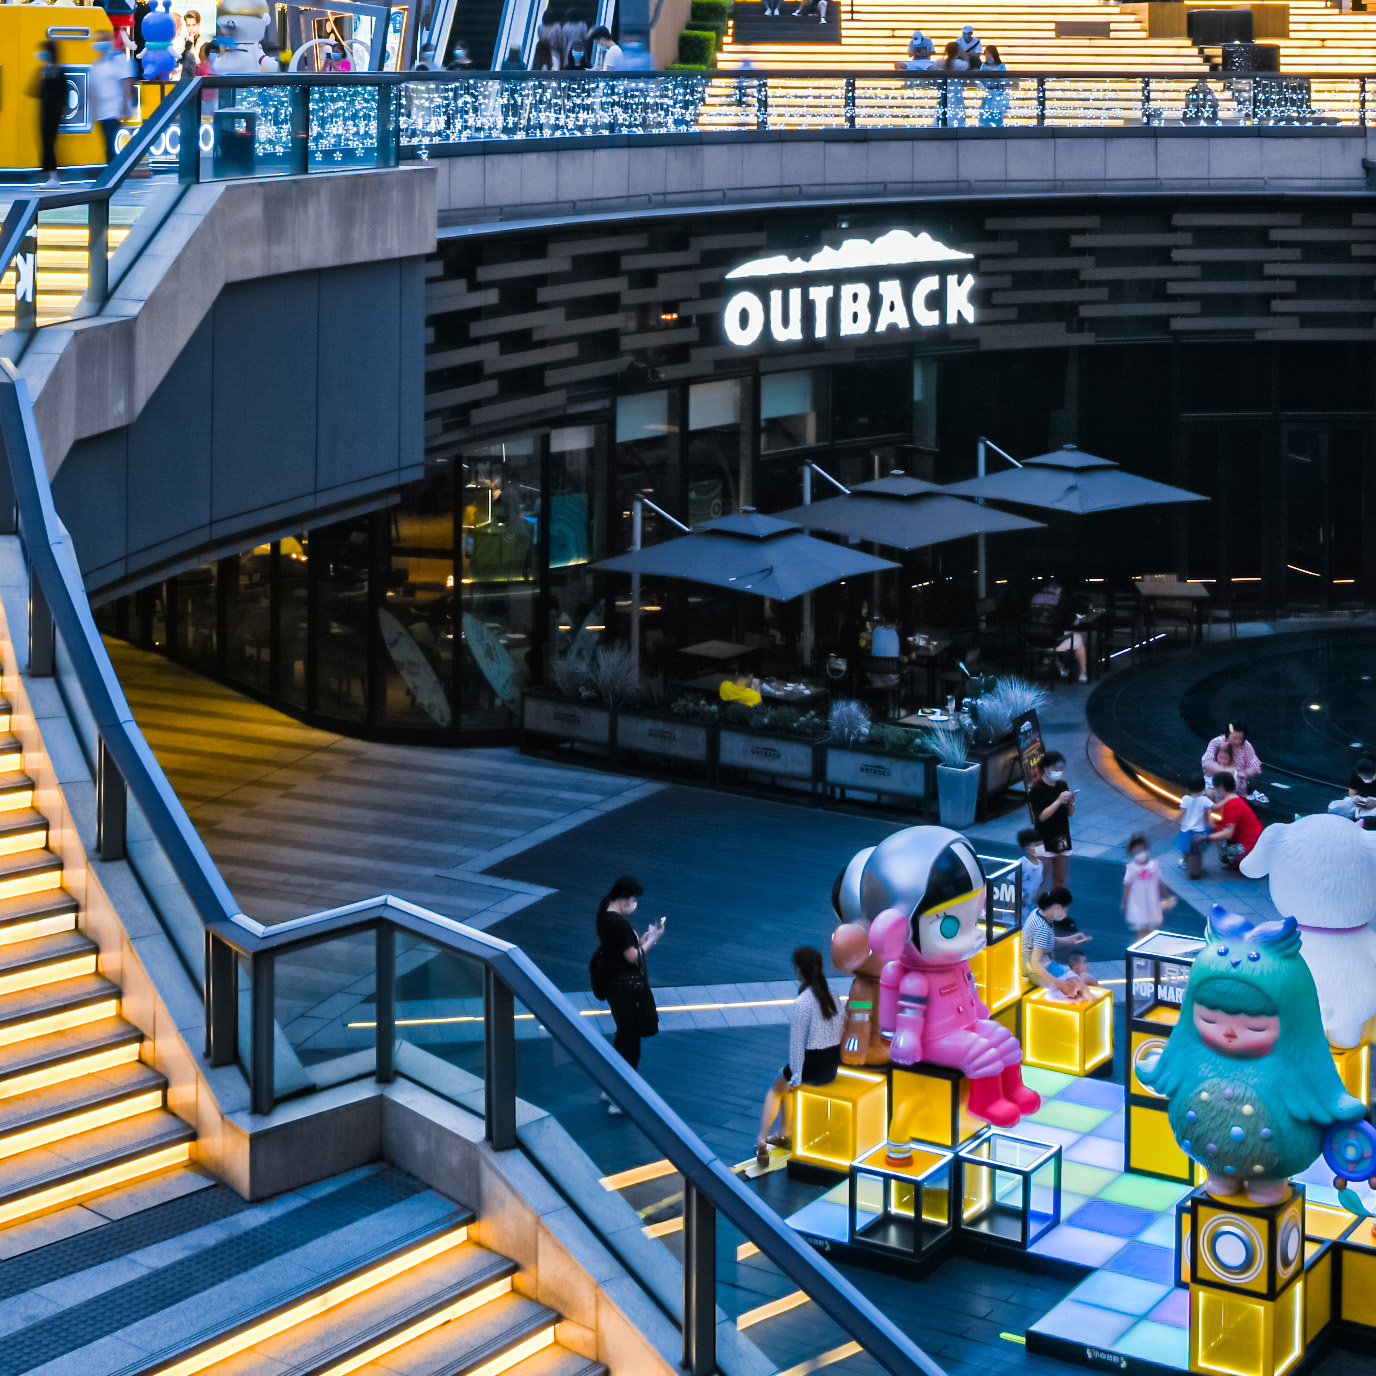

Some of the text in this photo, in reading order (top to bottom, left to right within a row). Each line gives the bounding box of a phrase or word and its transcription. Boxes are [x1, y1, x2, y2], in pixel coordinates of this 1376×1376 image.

[724, 273, 976, 346] OUTBACK
[1132, 982, 1185, 1004] POP MAR
